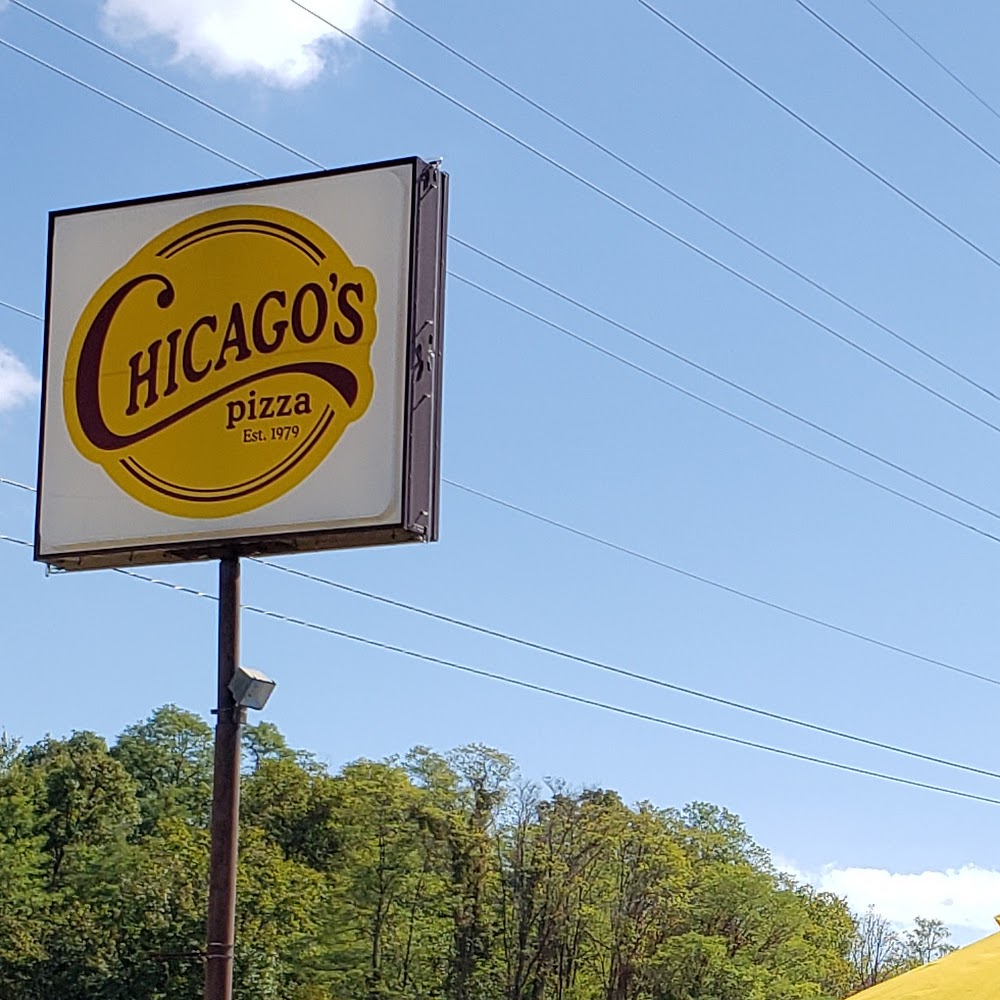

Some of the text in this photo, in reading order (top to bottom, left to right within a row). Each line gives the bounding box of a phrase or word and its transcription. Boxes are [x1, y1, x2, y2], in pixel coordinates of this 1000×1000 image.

[76, 273, 364, 450] CHICAGO'S
[226, 390, 312, 430] pizza
[243, 425, 299, 443] Est. 1979
